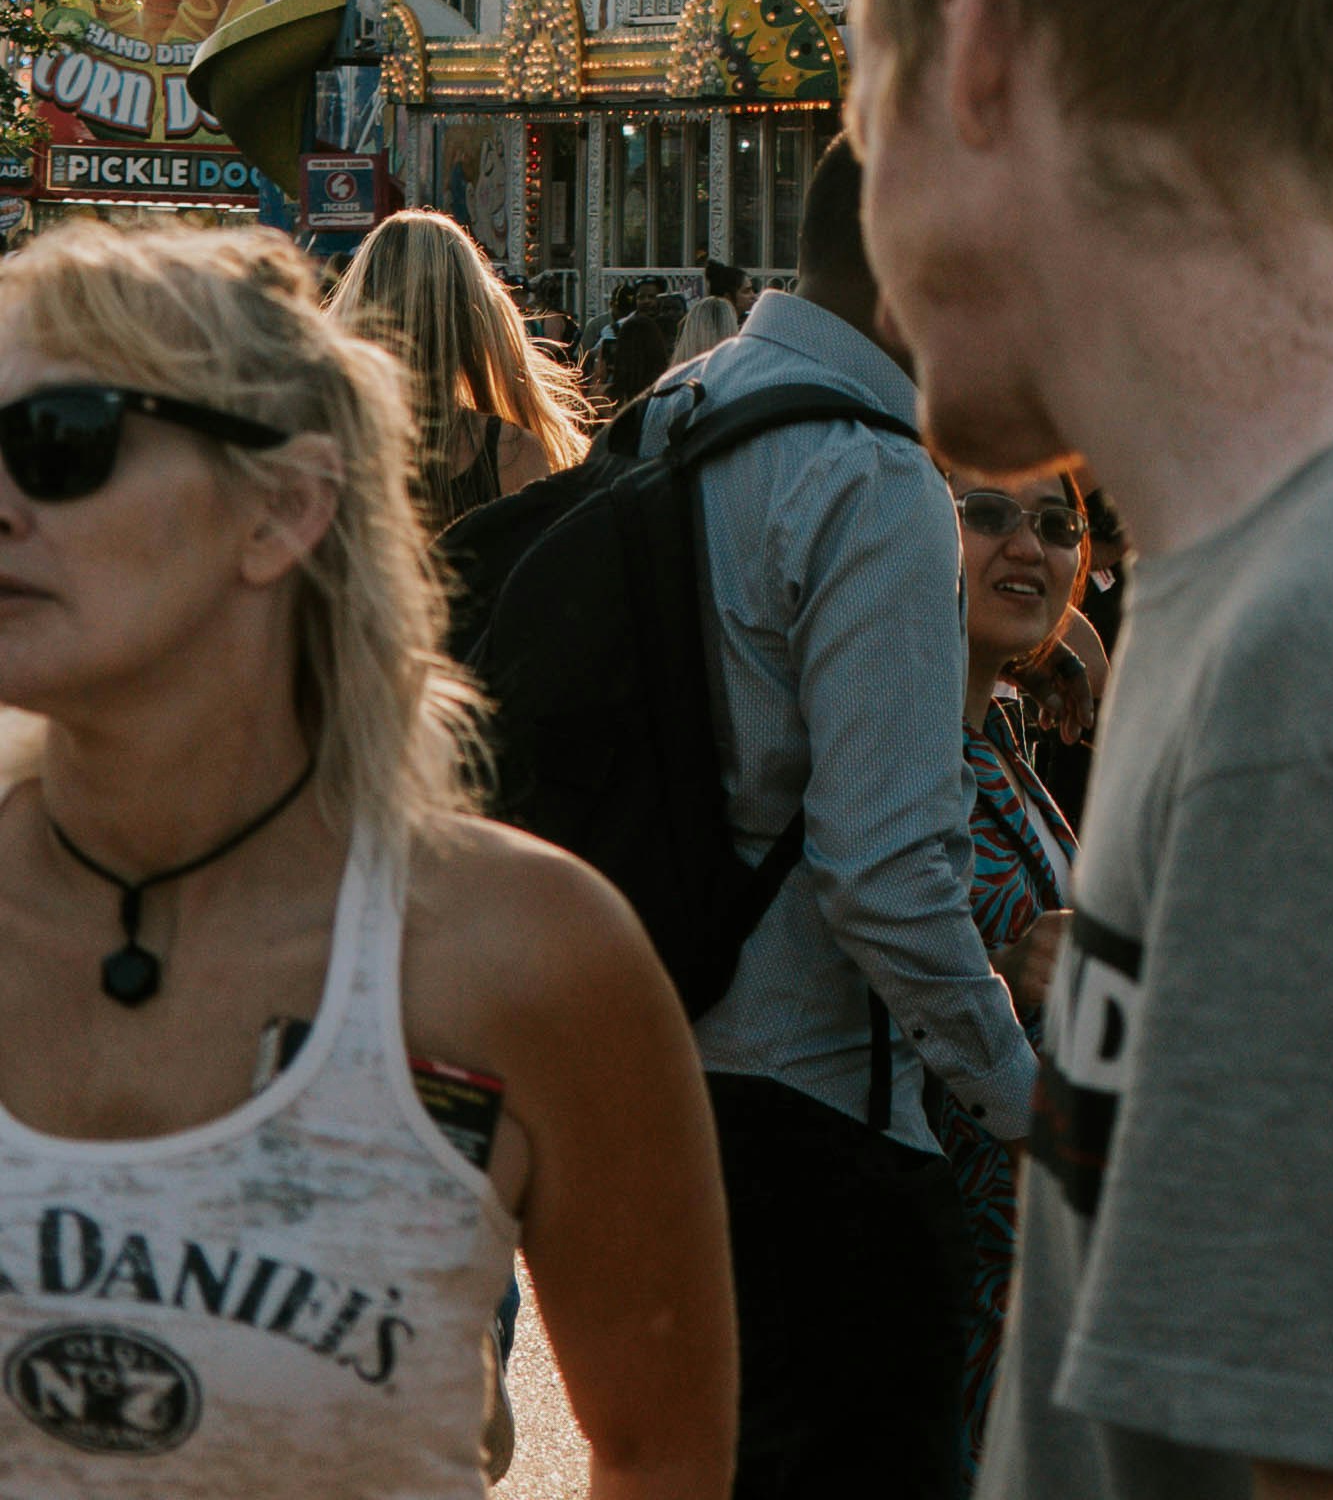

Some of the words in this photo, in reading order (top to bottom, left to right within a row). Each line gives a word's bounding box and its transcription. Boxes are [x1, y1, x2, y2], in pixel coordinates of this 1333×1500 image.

[86, 22, 152, 63] HAND
[156, 43, 203, 66] DIP
[34, 47, 152, 130] CORN
[67, 155, 189, 186] PICKLE
[331, 174, 350, 198] 4
[322, 202, 360, 213] TICKETS
